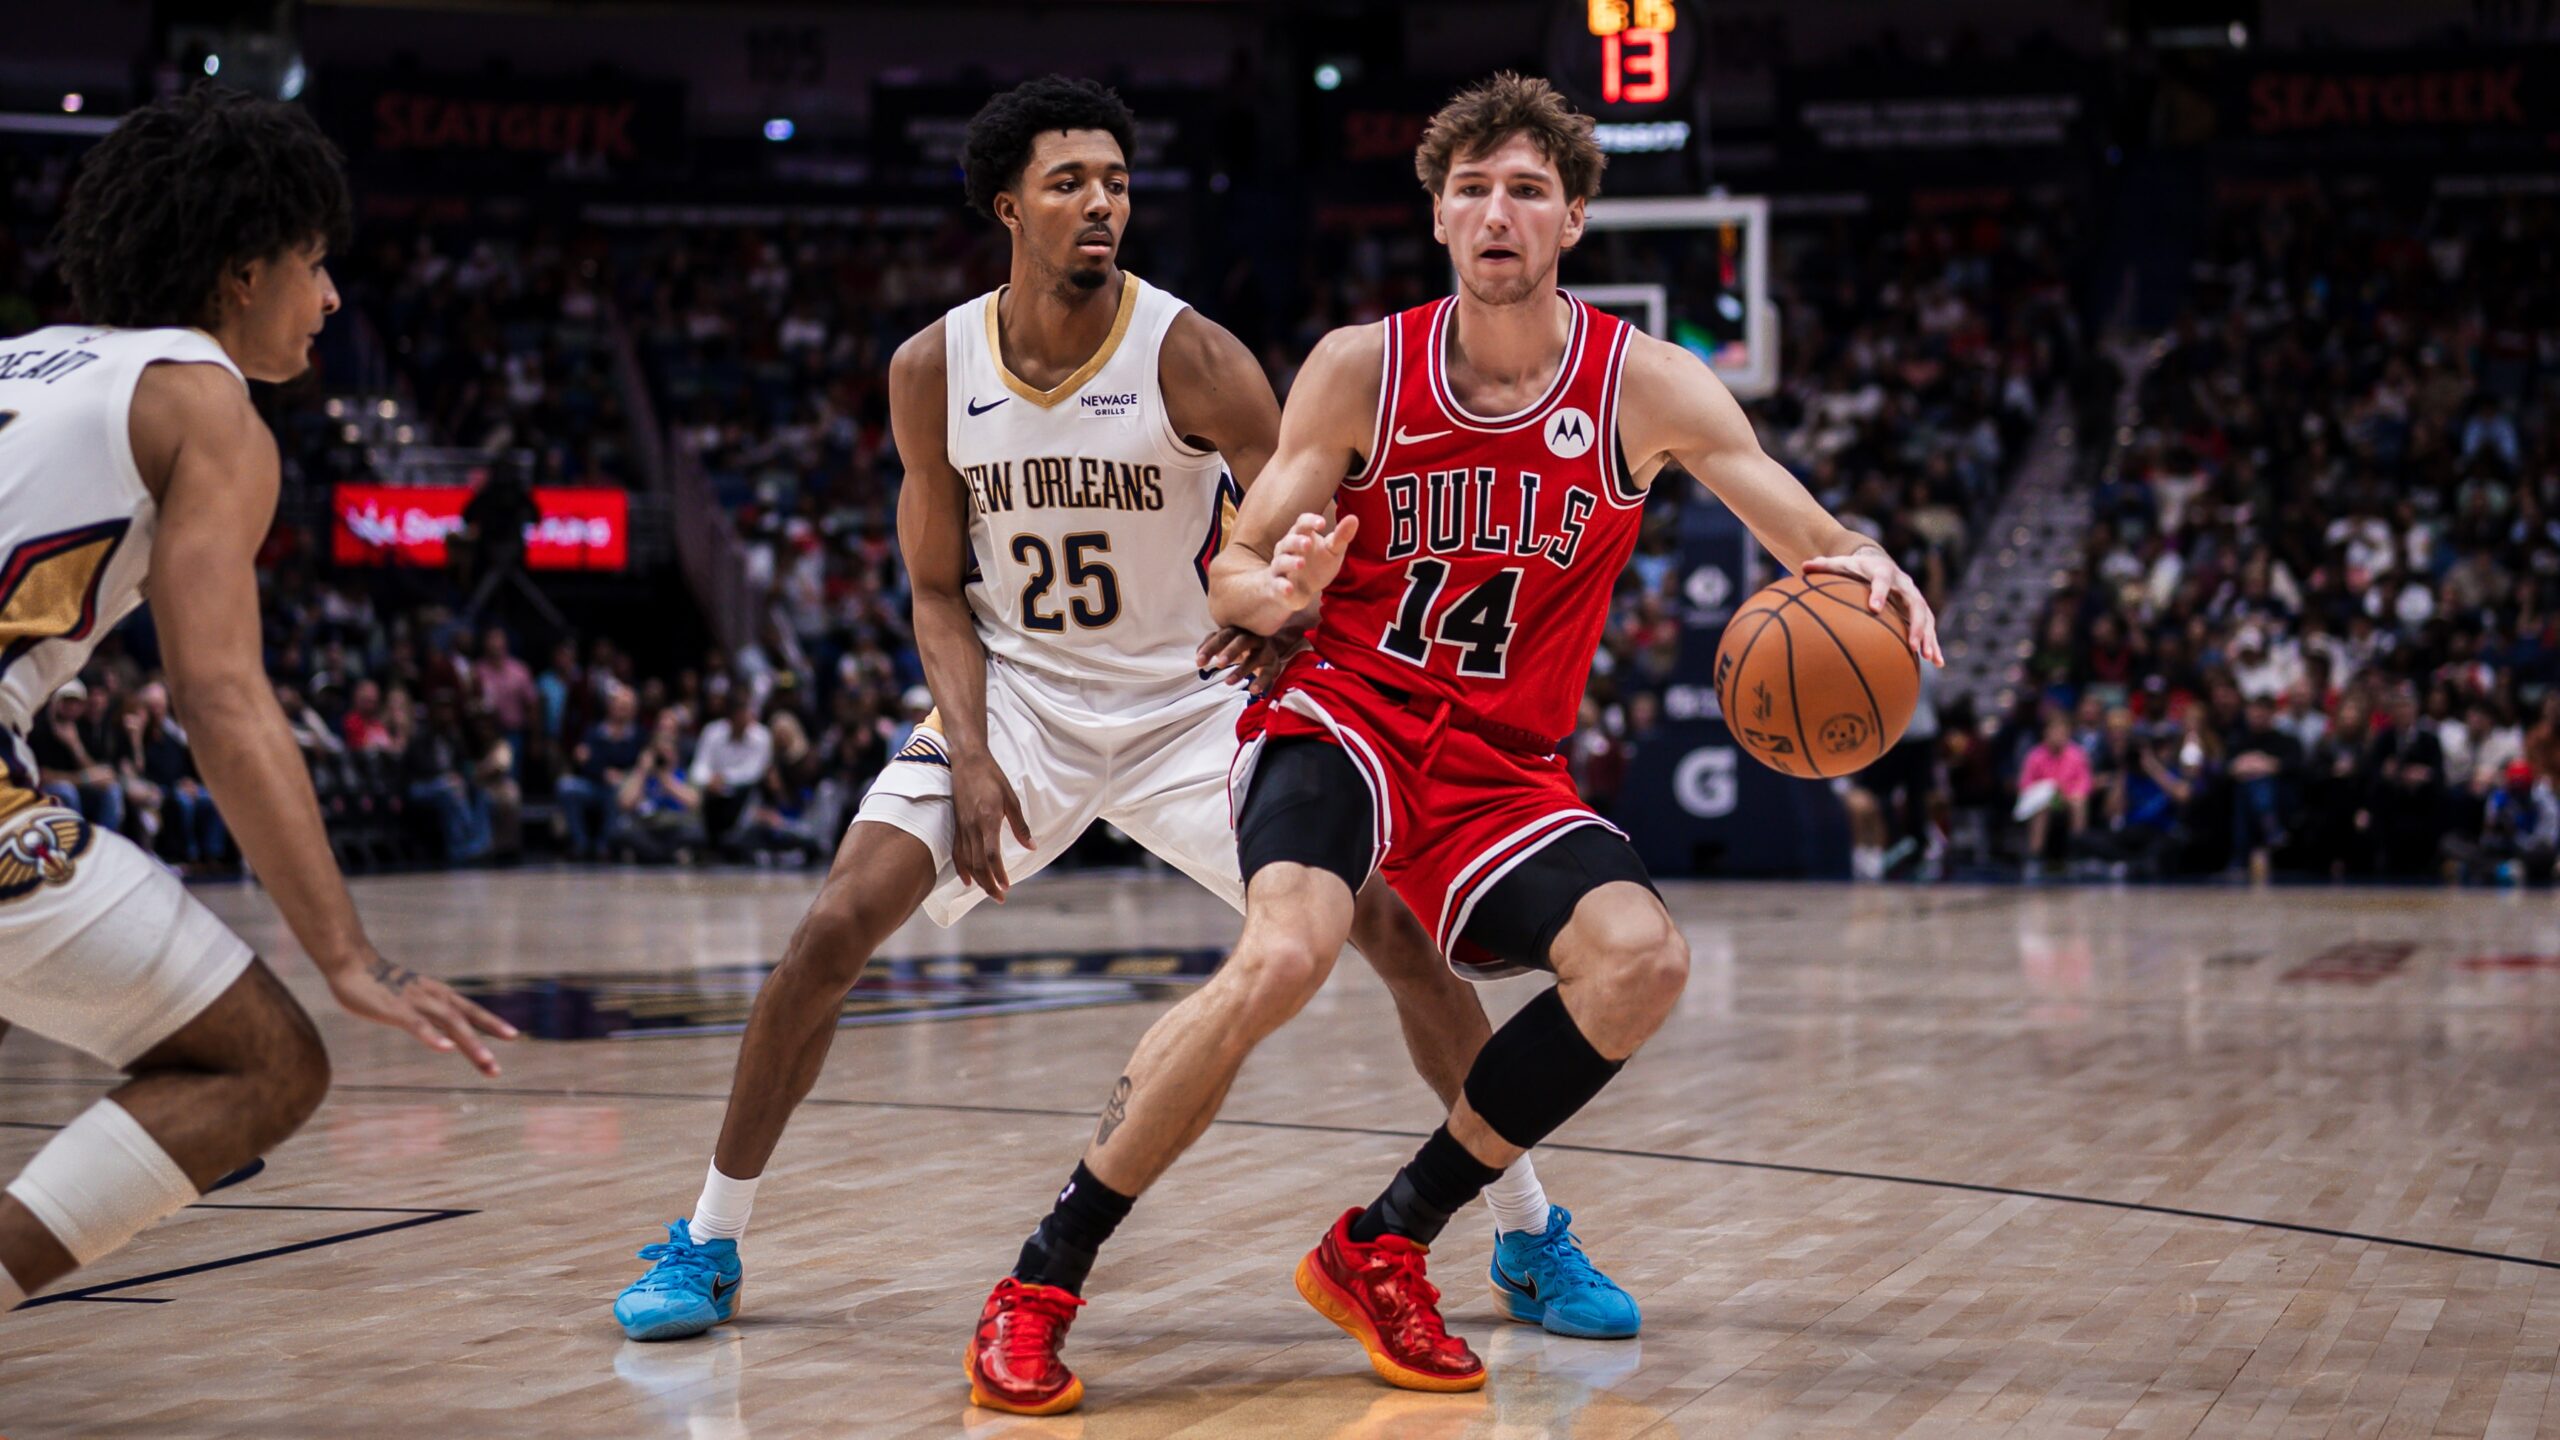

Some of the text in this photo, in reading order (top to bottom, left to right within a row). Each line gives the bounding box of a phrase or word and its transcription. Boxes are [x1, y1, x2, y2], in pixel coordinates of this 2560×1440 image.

[1602, 28, 1669, 103] 13
[1081, 393, 1137, 407] NEWAGE
[1095, 408, 1125, 416] GRILLS
[1023, 456, 1165, 512] ORLEANS
[1384, 467, 1598, 569] BULLS
[1009, 531, 1122, 634] 25
[1377, 556, 1525, 679] 14
[1673, 746, 1738, 818] G
